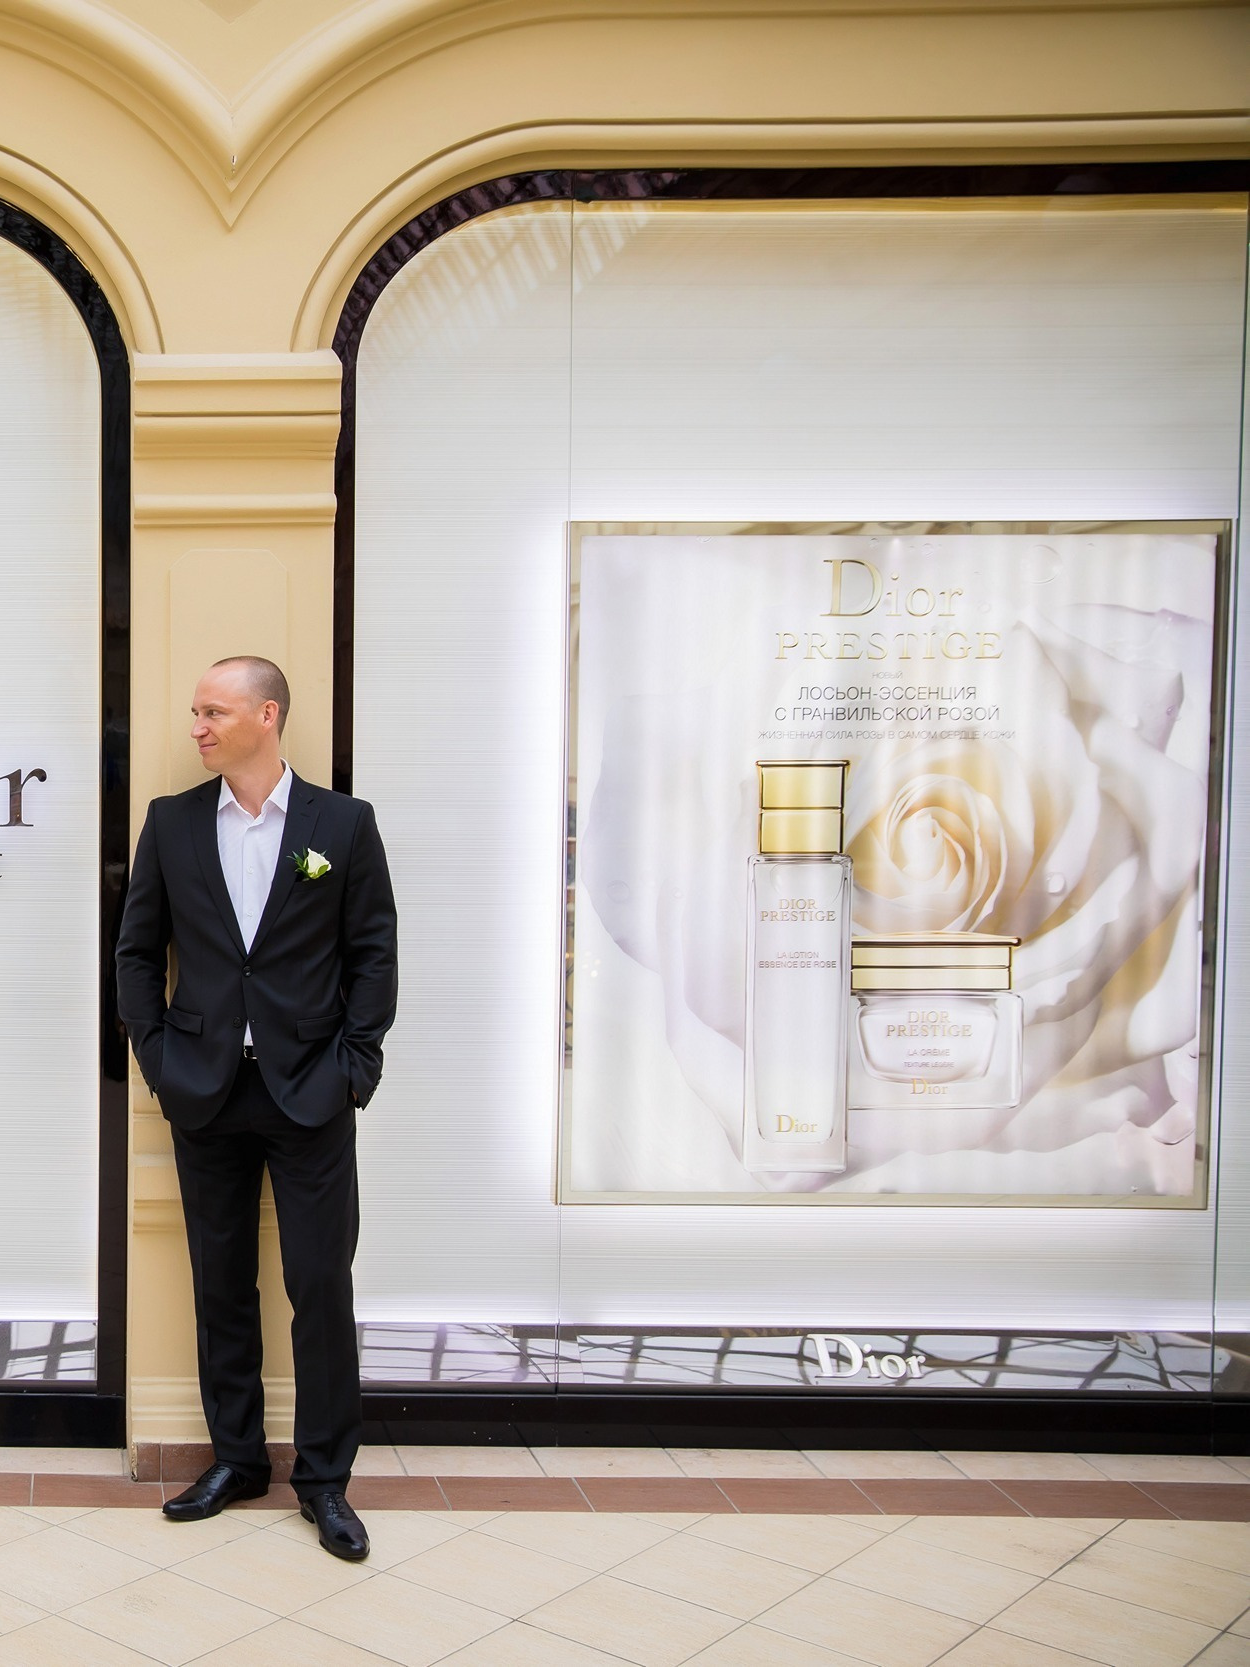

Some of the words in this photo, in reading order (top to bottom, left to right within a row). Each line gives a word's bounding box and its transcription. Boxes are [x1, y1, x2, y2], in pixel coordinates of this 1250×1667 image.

[820, 558, 964, 617] Dior
[774, 632, 1004, 660] PRESTIGE
[798, 686, 977, 703] ЛОСЬОН-ЭССЕНЦИЯ
[774, 707, 787, 721] С
[792, 704, 932, 721] ГРАНВИЛЬСКОЙ
[938, 704, 1000, 721] РОЗОЙ
[758, 730, 823, 741] ЖИЗНЕННАЯ
[825, 730, 854, 741] СИЛА
[856, 730, 887, 741] РОЗЫ
[888, 730, 895, 741] В
[898, 730, 938, 741] САМОМ
[940, 730, 980, 741] СЕРДЦЕ
[983, 730, 1016, 741] КОЖИ
[779, 898, 817, 910] DIOR
[760, 910, 837, 922] PRESTIGE
[777, 951, 788, 959] LA
[789, 951, 820, 959] LOTION
[759, 960, 797, 969] ESSENCE
[799, 960, 812, 969] DE
[814, 960, 837, 969] ROSE
[908, 1010, 951, 1024] DIOR
[886, 1024, 973, 1037] PRESTIGE
[910, 1077, 948, 1095] Dior
[775, 1114, 818, 1133] Dior
[806, 1334, 926, 1379] Dior
